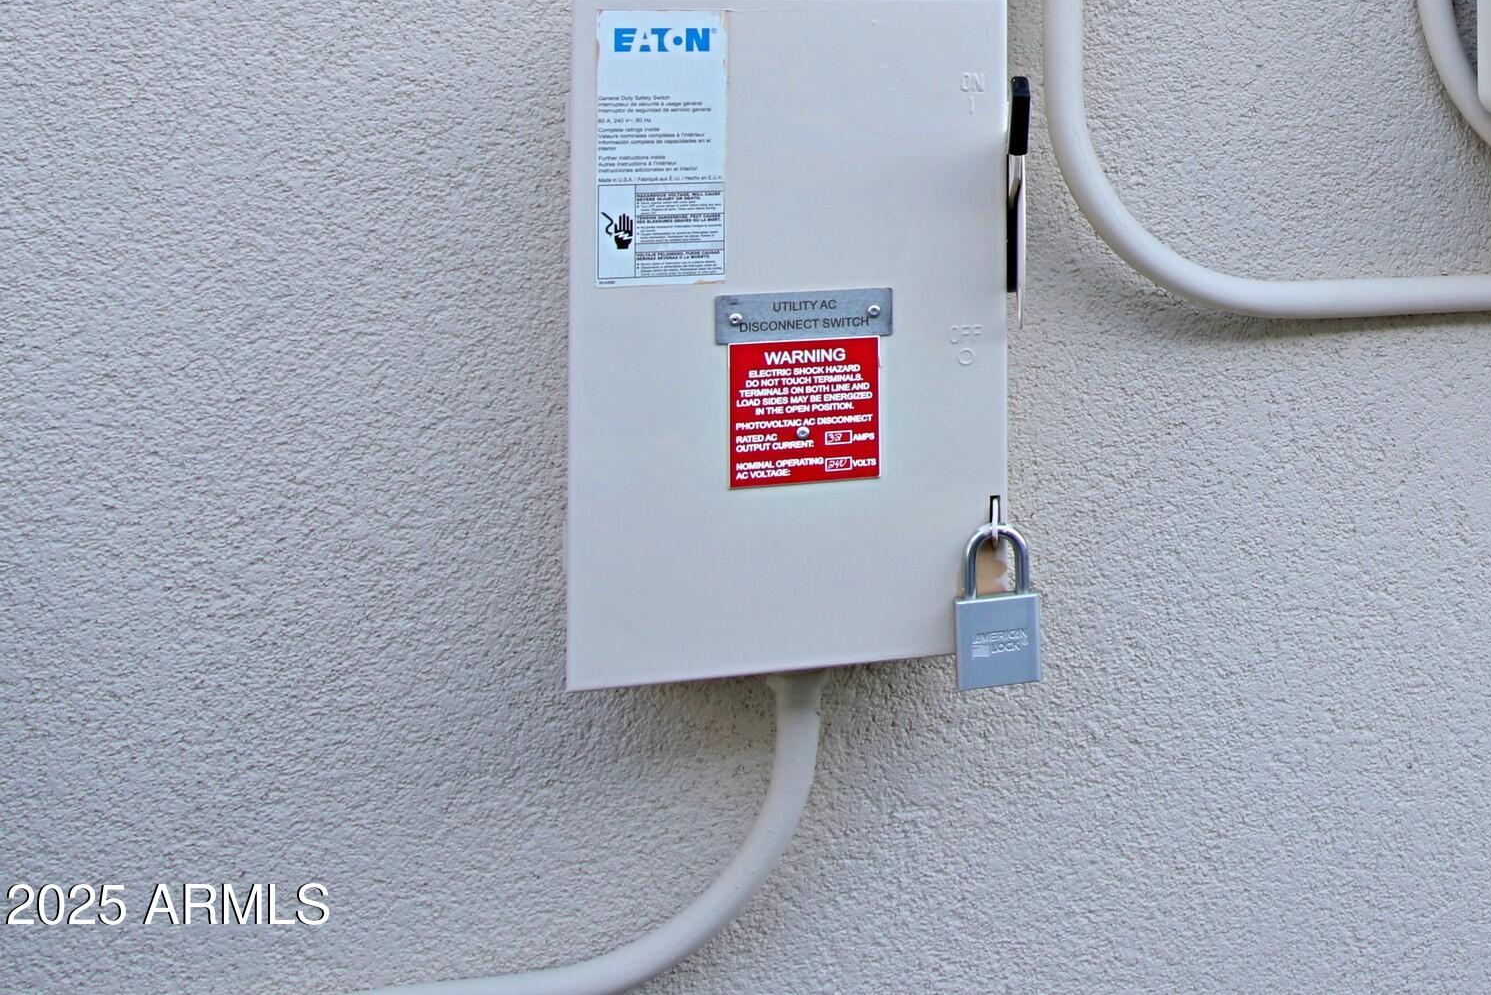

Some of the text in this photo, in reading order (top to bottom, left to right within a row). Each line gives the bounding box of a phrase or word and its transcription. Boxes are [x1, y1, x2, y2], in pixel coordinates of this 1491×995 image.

[614, 28, 710, 52] EATON
[960, 71, 985, 92] ON
[772, 300, 836, 312] UTILITY AC
[739, 316, 869, 332] DISCONNECT SWITCH
[764, 348, 846, 365] WARNING
[748, 364, 860, 378] ELECTRIC SHOCK HAZARD
[761, 378, 779, 387] NOT
[780, 376, 811, 385] TOUCH
[813, 374, 863, 383] TERMINALS.
[739, 387, 789, 397] TERMINALS
[805, 385, 829, 393] BOTH
[831, 383, 850, 392] LINE
[851, 382, 870, 390] AND
[736, 399, 760, 407] LOAD
[762, 397, 788, 406] SIDES
[790, 396, 808, 404] MAY
[824, 392, 873, 402] ENERGIZED
[755, 402, 854, 415] IN THE OPEN POSITION.
[736, 414, 873, 430] PHOTOVOLTAIC AC DISCONNECT
[736, 434, 777, 443] RATED AC
[853, 433, 875, 441] AMPS
[736, 440, 814, 452] OUTPUT CURRENT:
[736, 457, 824, 470] NOMINAL OPERATING
[852, 458, 876, 467] VOLTS
[736, 469, 791, 480] AC VOLTAGE:
[972, 628, 1028, 644] AMERICAN
[992, 642, 1021, 654] LOCK
